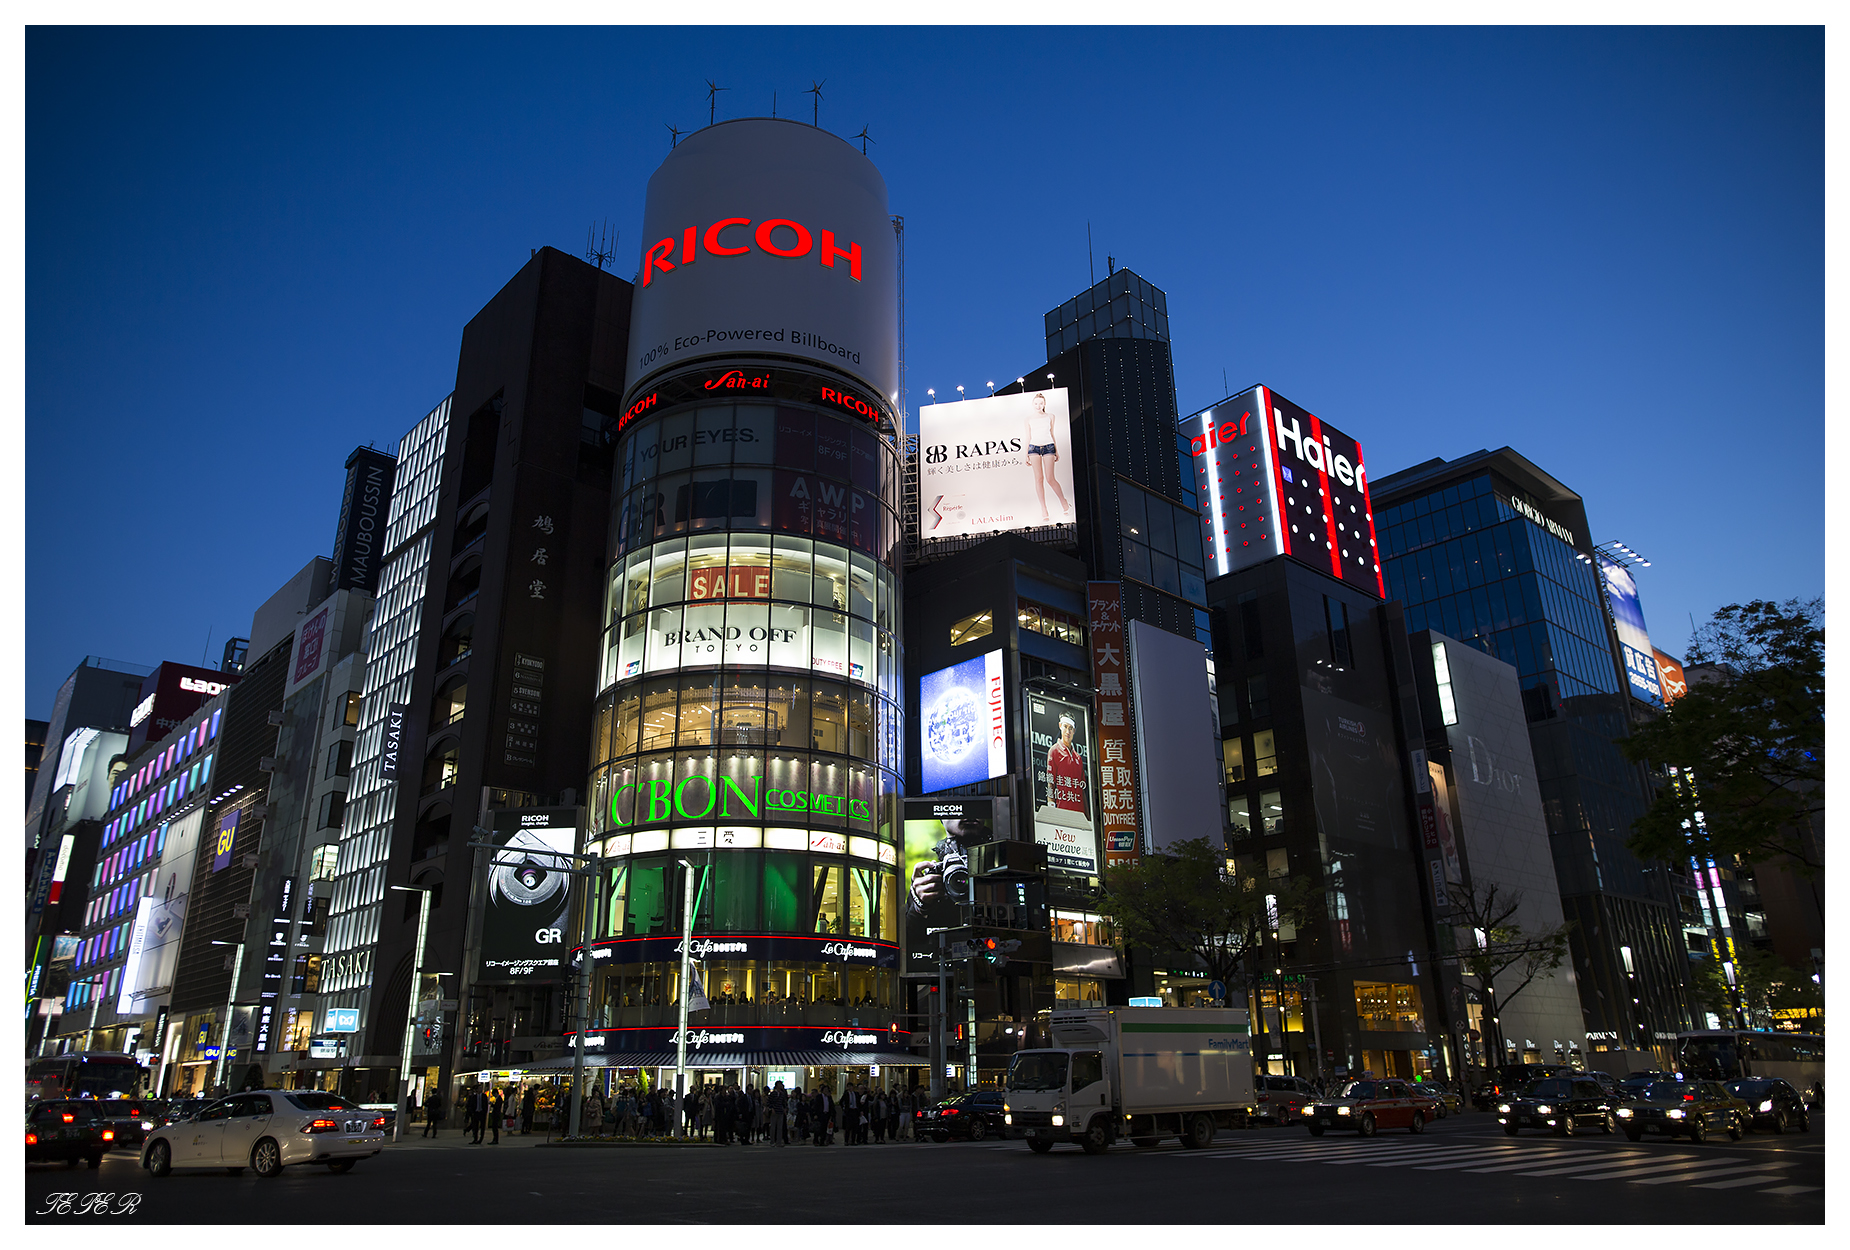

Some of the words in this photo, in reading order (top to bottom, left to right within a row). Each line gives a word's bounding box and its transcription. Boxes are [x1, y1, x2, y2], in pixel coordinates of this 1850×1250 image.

[643, 217, 863, 288] RICOH
[640, 342, 669, 370] 100%
[674, 328, 785, 351] Eco-Powered
[791, 330, 861, 365] Billboard
[618, 393, 658, 432] RICOH
[821, 387, 879, 422] RICOH
[640, 435, 688, 462] YOUR
[693, 428, 759, 445] EYES.
[817, 445, 848, 461] 8F/9F
[955, 438, 1022, 459] RAPAS
[1273, 407, 1366, 494] Haier
[350, 465, 385, 585] MAUBOUSSIN
[528, 514, 555, 600] 鳩居堂
[692, 574, 770, 599] SALE
[1089, 600, 1120, 612] ブランド
[1100, 611, 1110, 620] &
[664, 626, 741, 647] BRAND
[749, 627, 797, 643] OFF
[1090, 620, 1121, 633] チケット
[812, 657, 827, 666] DUTY
[827, 660, 843, 670] FREE
[1097, 642, 1126, 727] 大黒屋
[988, 675, 1005, 750] FUJITEC
[383, 710, 404, 772] TASAKI
[1103, 738, 1126, 763] 質
[1467, 735, 1522, 794] Dior
[1100, 766, 1132, 787] 買取
[611, 775, 763, 827] C'BON
[764, 788, 870, 821] COSMETCS
[1045, 786, 1081, 802] 進化と共に
[1101, 788, 1134, 810] 販売
[521, 814, 549, 822] RICOH
[933, 804, 963, 812] RICOH
[217, 826, 236, 856] GU
[1054, 828, 1076, 843] New
[535, 928, 562, 944] GR
[821, 943, 834, 954] Le
[834, 943, 854, 961] Café
[321, 950, 372, 981] TASAKI
[509, 966, 535, 975] 8F/9F
[821, 1031, 834, 1044] Le
[834, 1030, 854, 1049] Café
[1208, 1038, 1249, 1050] FamilyMart
